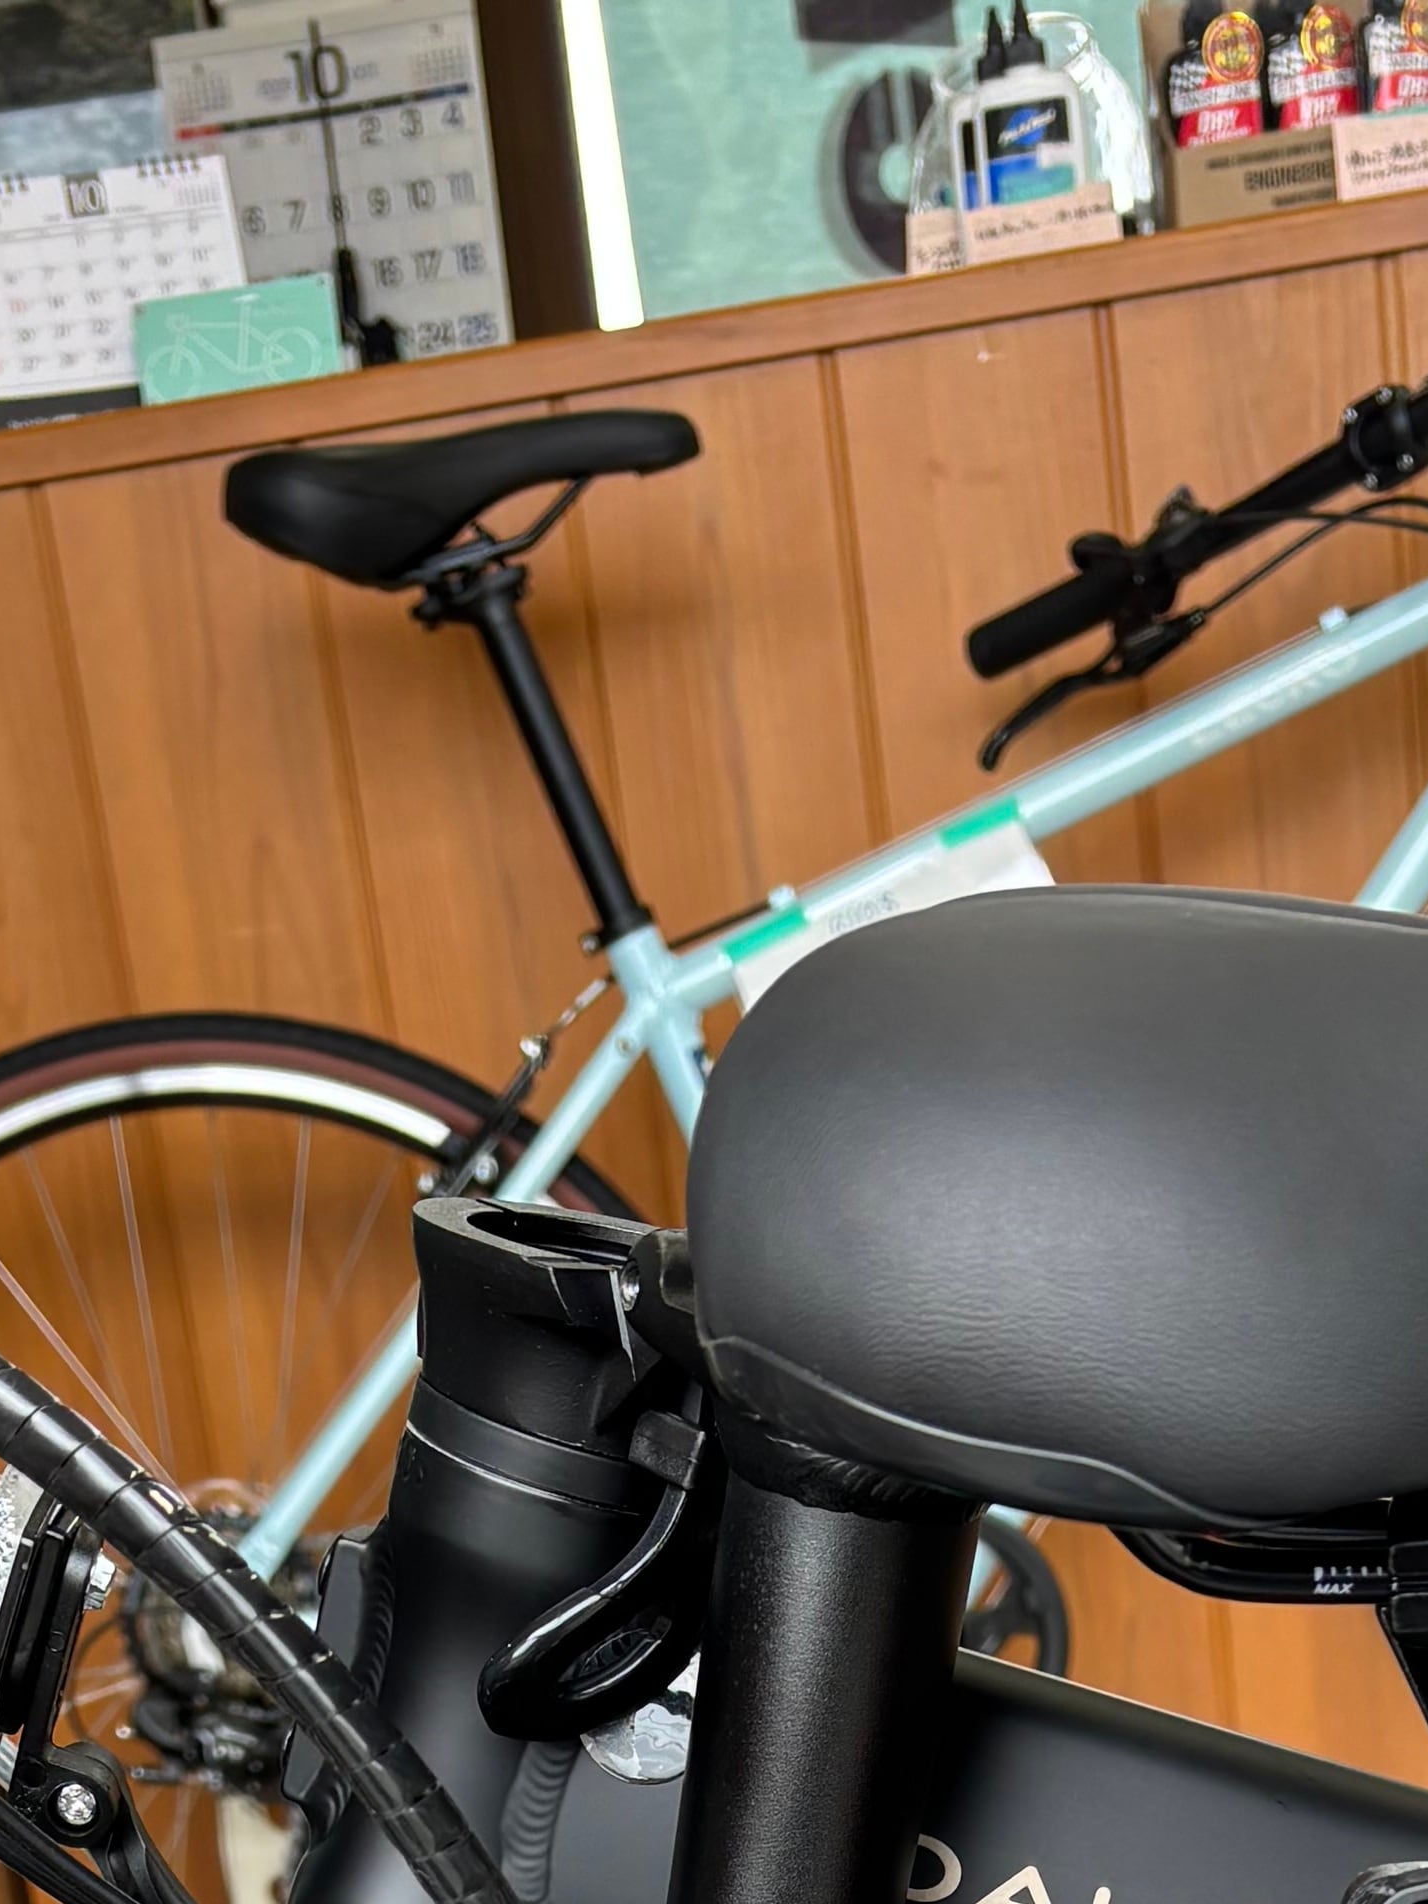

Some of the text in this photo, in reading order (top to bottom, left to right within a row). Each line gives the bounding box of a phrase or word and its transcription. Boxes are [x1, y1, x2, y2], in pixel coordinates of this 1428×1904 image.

[285, 46, 348, 103] 10
[359, 115, 381, 145] 2
[401, 108, 423, 138] 3
[68, 180, 107, 214] 10
[283, 200, 306, 232] 7
[368, 187, 391, 218] 9
[407, 179, 435, 212] 10
[1313, 1583, 1356, 1596] MAX
